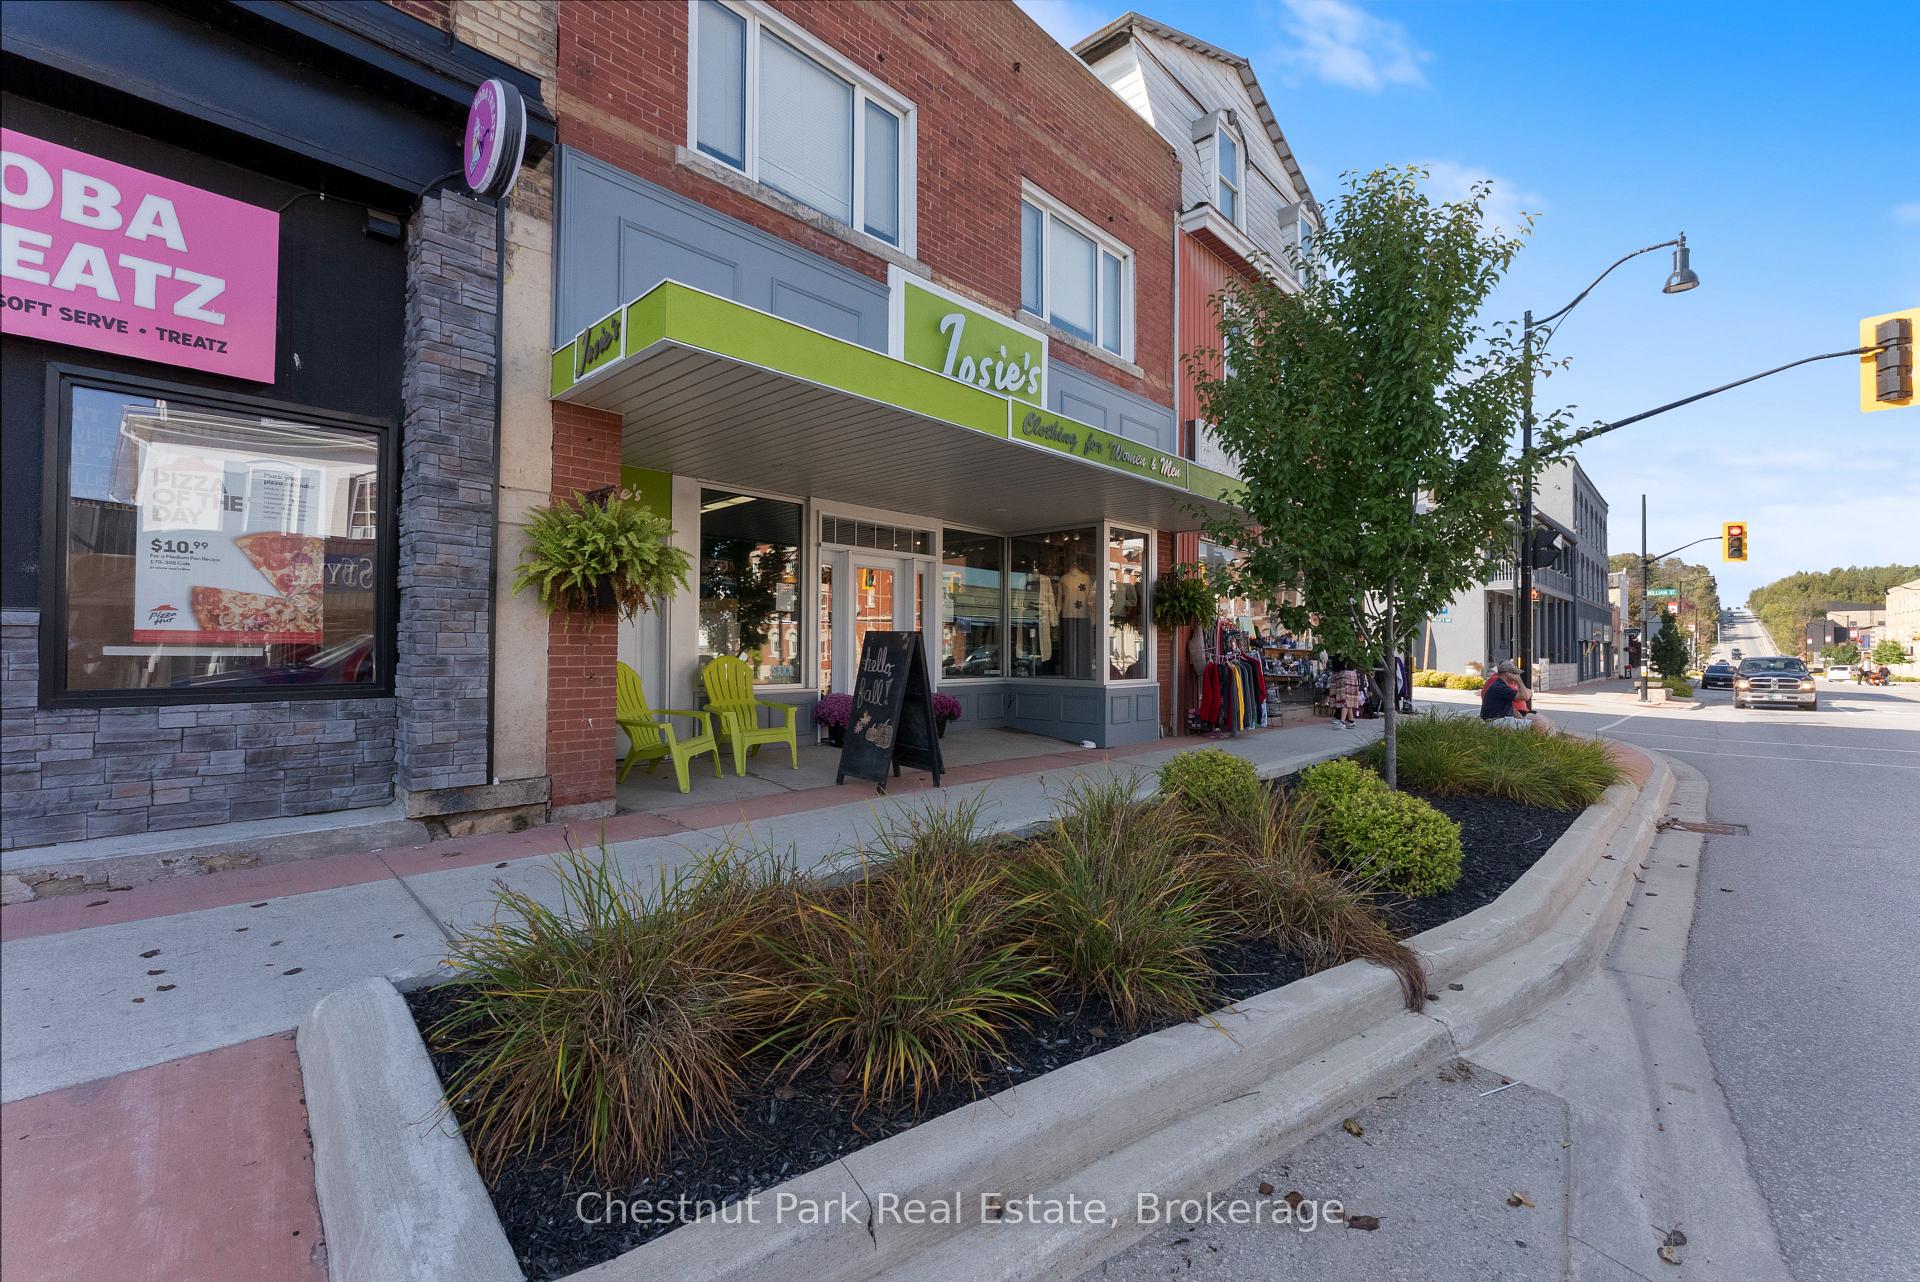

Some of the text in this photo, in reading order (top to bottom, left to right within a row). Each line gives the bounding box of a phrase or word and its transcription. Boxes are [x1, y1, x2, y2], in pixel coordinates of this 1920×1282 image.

[59, 307, 129, 334] SERVE
[156, 327, 228, 354] TREATZ
[1022, 412, 1181, 479] Clothing for Women & Men
[152, 488, 191, 507] OF
[151, 538, 209, 555] $10.99
